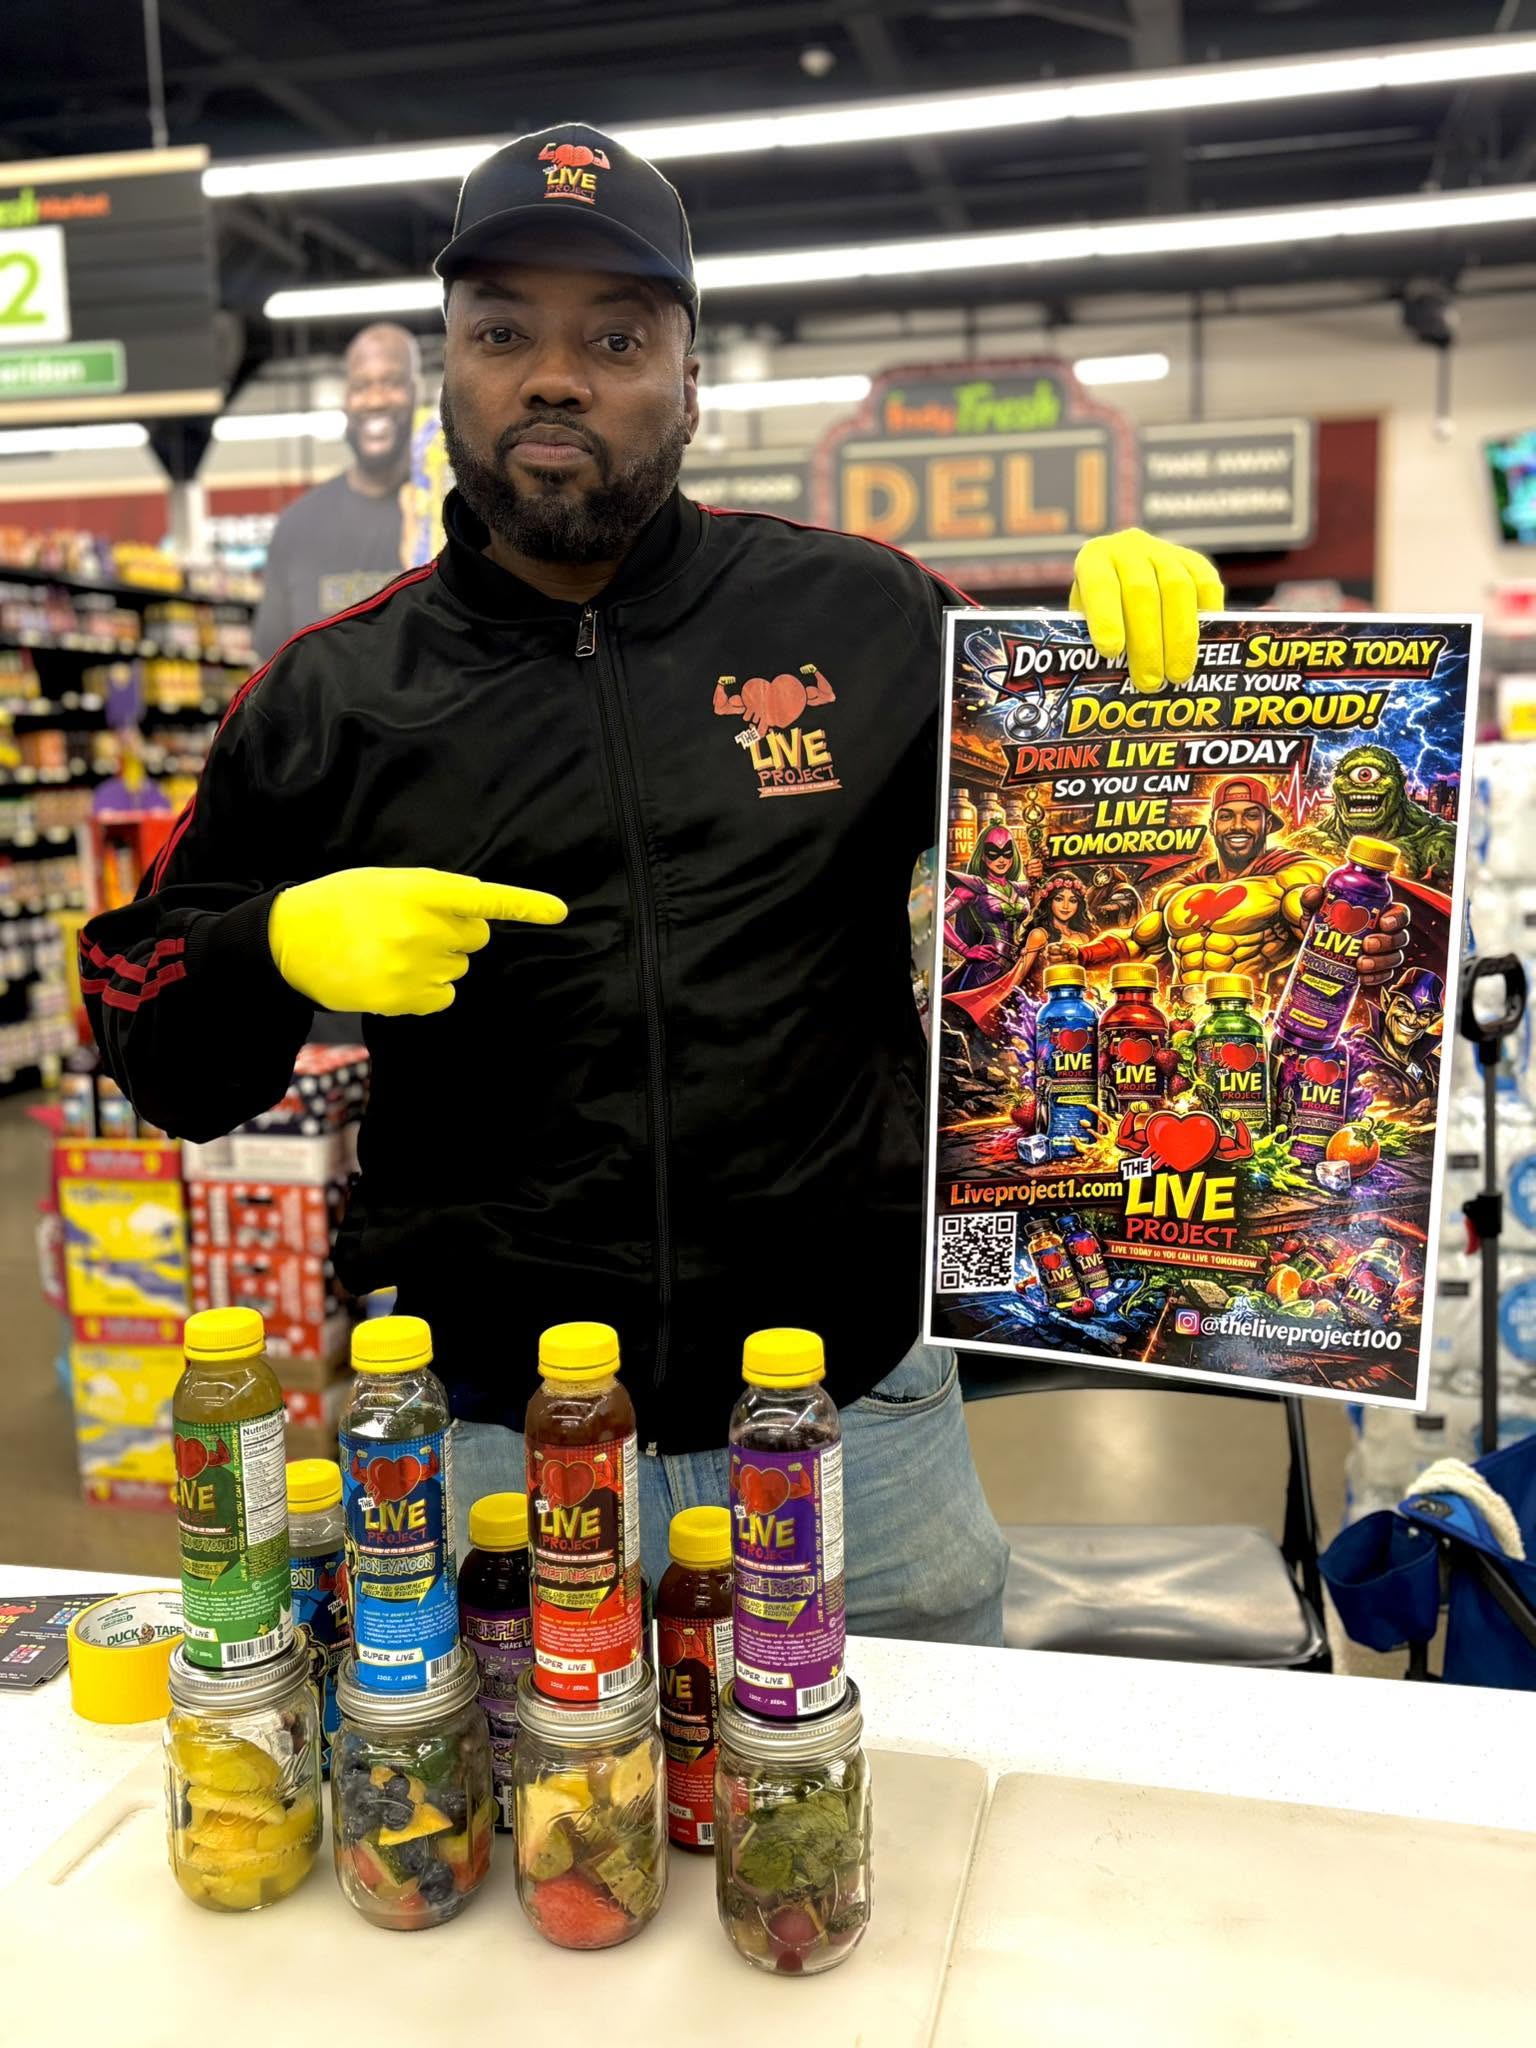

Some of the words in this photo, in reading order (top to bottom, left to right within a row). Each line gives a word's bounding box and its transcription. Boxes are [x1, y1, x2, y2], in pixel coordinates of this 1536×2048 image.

[546, 167, 597, 190] LIVE
[547, 184, 596, 199] PROJECT
[842, 447, 1104, 545] DELI
[1013, 645, 1051, 677] DO
[1058, 647, 1100, 671] YOU
[1196, 643, 1241, 667] FEEL
[1245, 635, 1346, 668] SUPER
[1352, 640, 1440, 666] TODAY
[1174, 673, 1238, 692] MAKE
[1242, 673, 1303, 692] YOUR
[1067, 696, 1219, 734] DOCTOR
[1232, 693, 1382, 726] PROUD!
[738, 728, 760, 748] THE
[750, 727, 832, 771] LIVE
[1015, 745, 1102, 775] DRINK
[1106, 740, 1178, 769] LIVE
[1184, 738, 1299, 766] TODAY
[758, 764, 834, 787] PROJECT
[1054, 777, 1089, 798] SO
[1093, 776, 1138, 796] YOU
[1143, 774, 1190, 793] CAN
[1094, 800, 1167, 828] LIVE
[1050, 829, 1202, 857] TOMORROW
[1313, 930, 1362, 957] LIVE
[1055, 1052, 1093, 1072] LIVE
[1057, 1070, 1092, 1078] PROJECT
[1115, 1065, 1156, 1084] LIVE
[1220, 1071, 1262, 1092] LIVE
[1118, 1083, 1156, 1092] PROJECT
[1222, 1091, 1262, 1099] PROJECT
[1301, 1084, 1341, 1105] LIVE
[1302, 1102, 1340, 1112] PROJECT
[1124, 1161, 1149, 1178] THE
[950, 1178, 1123, 1206] Liveproject1.com
[1125, 1171, 1238, 1222] LIVE
[1127, 1217, 1238, 1249] PROJECT
[1081, 1253, 1104, 1270] LIVE
[1111, 1244, 1128, 1255] LIVE
[1129, 1246, 1153, 1258] TODAY
[1162, 1249, 1177, 1260] YOU
[1178, 1251, 1191, 1261] CAN
[1192, 1252, 1209, 1263] LIVE
[1210, 1255, 1258, 1269] TOMORROW
[1046, 1266, 1074, 1285] LIVE
[1347, 1287, 1382, 1310] LIVE
[1201, 1316, 1402, 1351] @theliveproject100
[243, 1419, 277, 1436] Nutrition
[232, 1428, 240, 1466] TOMORROW
[360, 1499, 374, 1509] THE
[237, 1518, 243, 1528] SO
[364, 1499, 427, 1533] LIVE
[541, 1506, 601, 1540] LIVE
[238, 1530, 246, 1550] TODAY
[367, 1527, 428, 1544] PROJECT
[738, 1513, 795, 1548] LIVE
[543, 1535, 600, 1552] PROJECT
[359, 1552, 436, 1576] HONEYMOON
[815, 1554, 822, 1564] SO
[770, 1576, 815, 1597] REIGN
[107, 1627, 140, 1646] DUCK
[195, 1629, 209, 1639] LIVE
[468, 1618, 524, 1640] PURPLE
[362, 1650, 390, 1661] SUPER
[396, 1652, 415, 1661] LIVE
[499, 1641, 523, 1650] SHAKE
[539, 1655, 563, 1669] SUPER
[568, 1663, 587, 1671] LIVE
[738, 1665, 761, 1680] SUPER
[765, 1677, 785, 1685] LIVE
